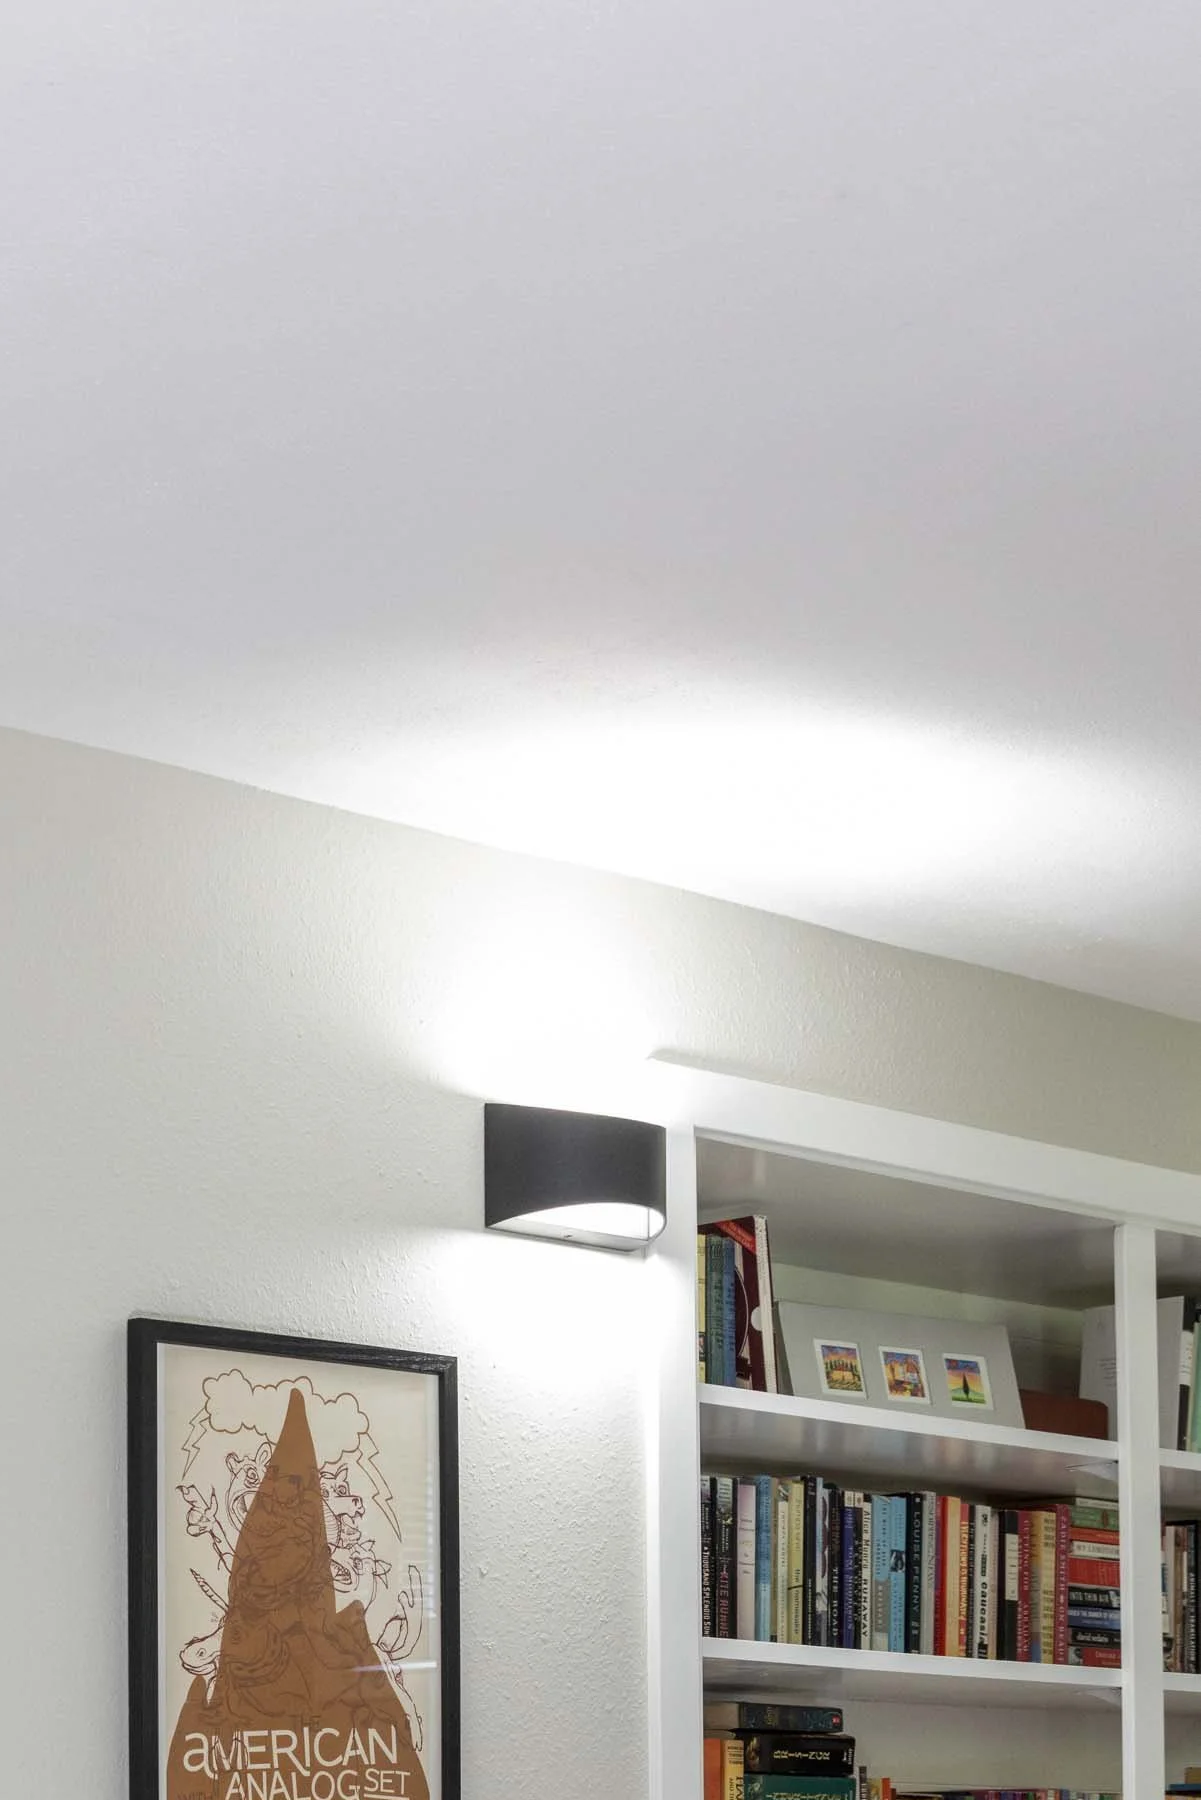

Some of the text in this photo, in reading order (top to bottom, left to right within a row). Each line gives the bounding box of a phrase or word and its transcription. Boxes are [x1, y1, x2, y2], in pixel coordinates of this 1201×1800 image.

[911, 1511, 921, 1613] LOUISE PENNY
[702, 1587, 711, 1620] SPLENDID
[719, 1571, 729, 1638] KITE RUNNE
[831, 1600, 839, 1637] ROAD
[861, 1578, 869, 1638] RUNAWAY
[703, 1621, 712, 1637] SUN
[1057, 1626, 1065, 1662] BEAUT
[364, 1768, 411, 1794] SET
